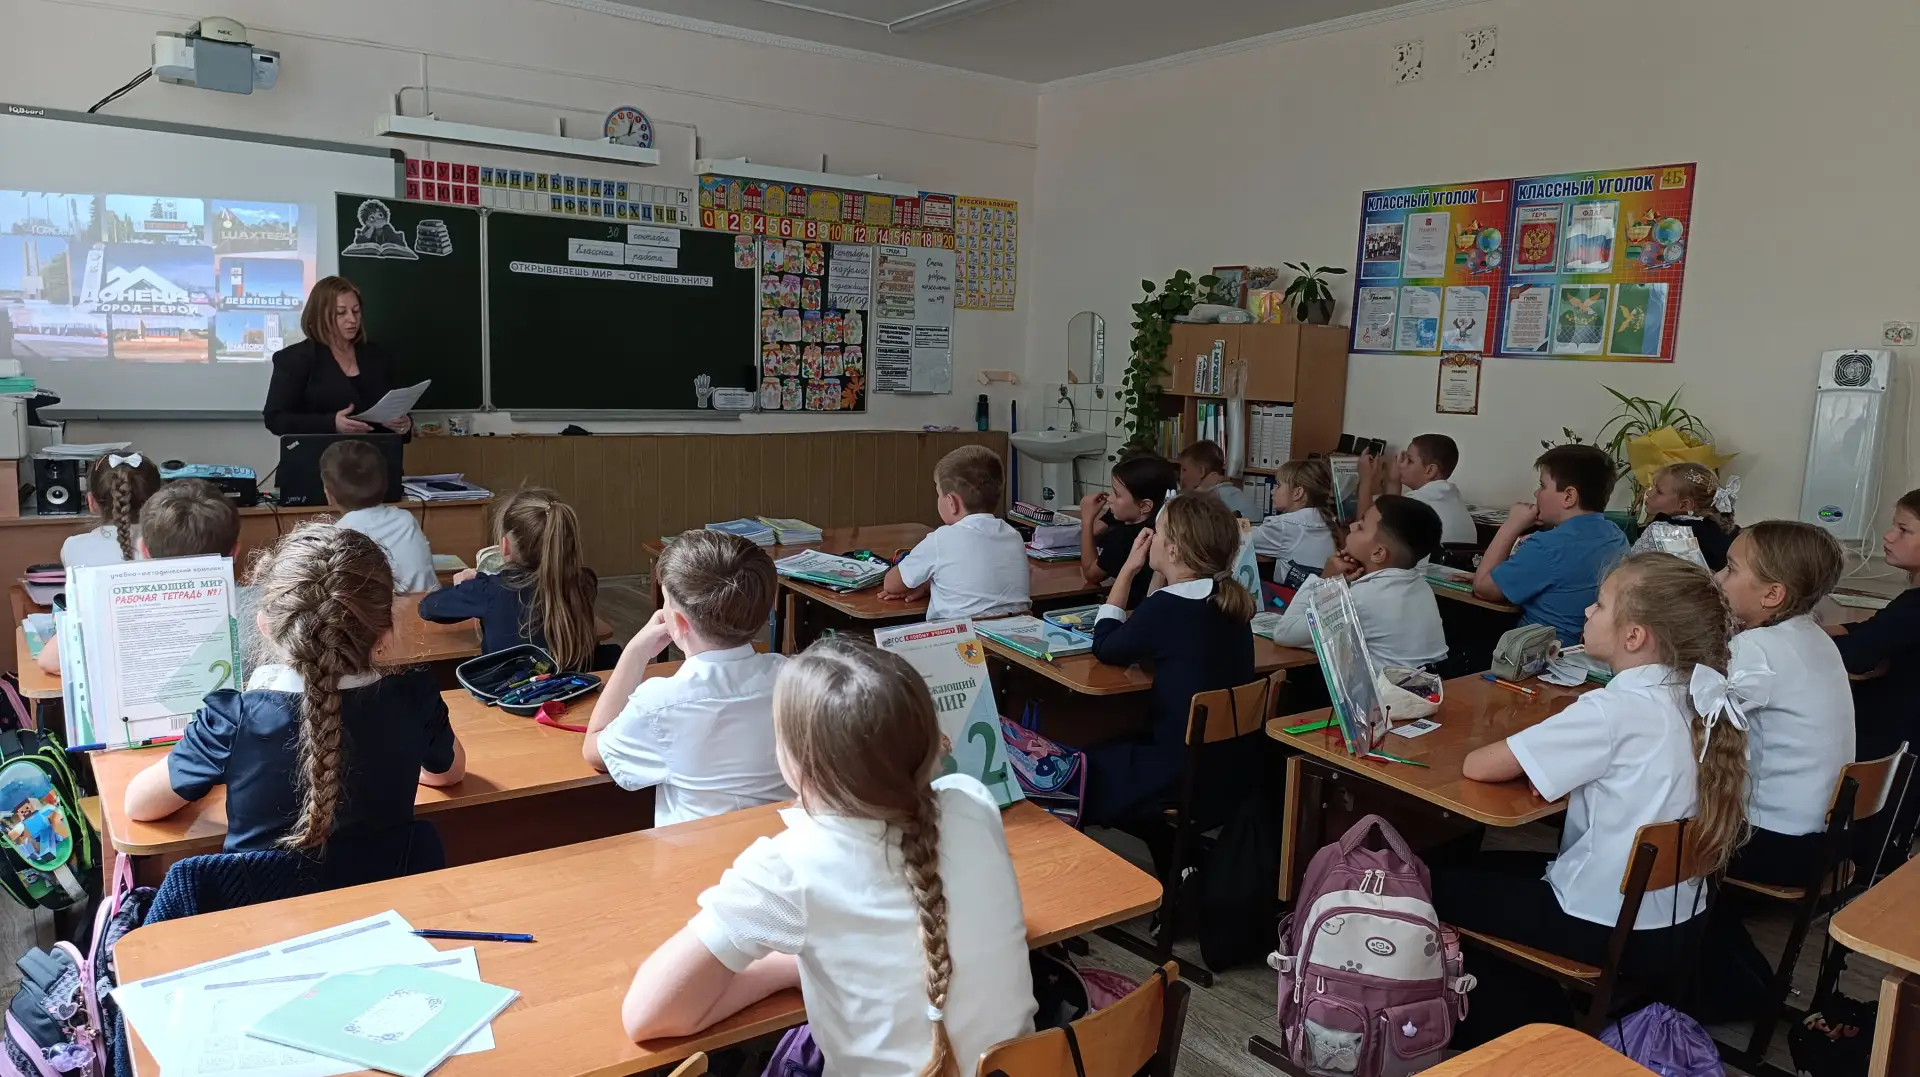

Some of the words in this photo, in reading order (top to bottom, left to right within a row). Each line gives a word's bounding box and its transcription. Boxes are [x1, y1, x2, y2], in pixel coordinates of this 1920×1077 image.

[8, 105, 44, 116] IQBoard
[408, 163, 417, 174] А
[424, 164, 432, 176] О
[439, 166, 447, 177] У
[453, 168, 464, 179] Ы
[469, 168, 476, 181] Э
[483, 171, 491, 182] Л
[497, 172, 507, 184] М
[511, 174, 520, 185] Н
[525, 175, 532, 186] Р
[539, 174, 546, 188] Й
[552, 178, 559, 189] Б
[566, 180, 573, 191] В
[580, 182, 586, 192] Г
[591, 183, 600, 195] Д
[604, 184, 614, 195] Ж
[618, 186, 625, 197] З
[679, 192, 687, 203] Ъ
[1662, 170, 1682, 184] 4Б
[1518, 176, 1594, 200] КЛАССНЫЙ
[1598, 174, 1654, 194] УГОЛОК
[408, 184, 417, 195] Я
[438, 187, 449, 198] Ю
[455, 190, 462, 200] И
[470, 190, 476, 201] Е
[552, 198, 562, 209] П
[565, 200, 575, 210] Ф
[580, 201, 588, 212] К
[592, 202, 600, 213] Т
[604, 204, 614, 215] Ш
[618, 205, 625, 216] С
[630, 206, 638, 217] Х
[643, 207, 651, 221] Ц
[656, 208, 663, 220] Ч
[680, 211, 686, 221] Ь
[1367, 190, 1430, 211] КЛАССНЫЙ
[1432, 189, 1478, 206] УГОЛОК
[607, 226, 620, 238] 30
[704, 211, 713, 227] 0
[718, 212, 724, 228] 1
[730, 214, 739, 230] 2
[744, 216, 752, 231] 3
[755, 217, 764, 233] 4
[769, 219, 777, 233] 5
[781, 220, 790, 235] 6
[794, 222, 803, 236] 7
[807, 222, 816, 238] 8
[819, 224, 828, 238] 9
[831, 226, 841, 240] 10
[844, 226, 852, 240] 11
[854, 227, 865, 242] 12
[867, 228, 877, 242] 13
[878, 229, 888, 244] 14
[890, 230, 900, 244] 15
[901, 231, 910, 245] 16
[912, 232, 920, 246] 17
[922, 232, 931, 247] 18
[933, 233, 942, 247] 19
[944, 234, 953, 248] 20
[576, 244, 614, 257] Классная
[632, 251, 664, 263] работа
[592, 270, 613, 278] МИР
[225, 297, 299, 306] ДЕБАЛЬЦЕВО
[113, 580, 195, 595] ОКРУЖАЮЩИЙ
[200, 580, 223, 588] МИР
[115, 593, 158, 604] РАБОЧАЯ
[162, 590, 202, 600] ТЕТРАДЬ
[968, 722, 1008, 786] 2
